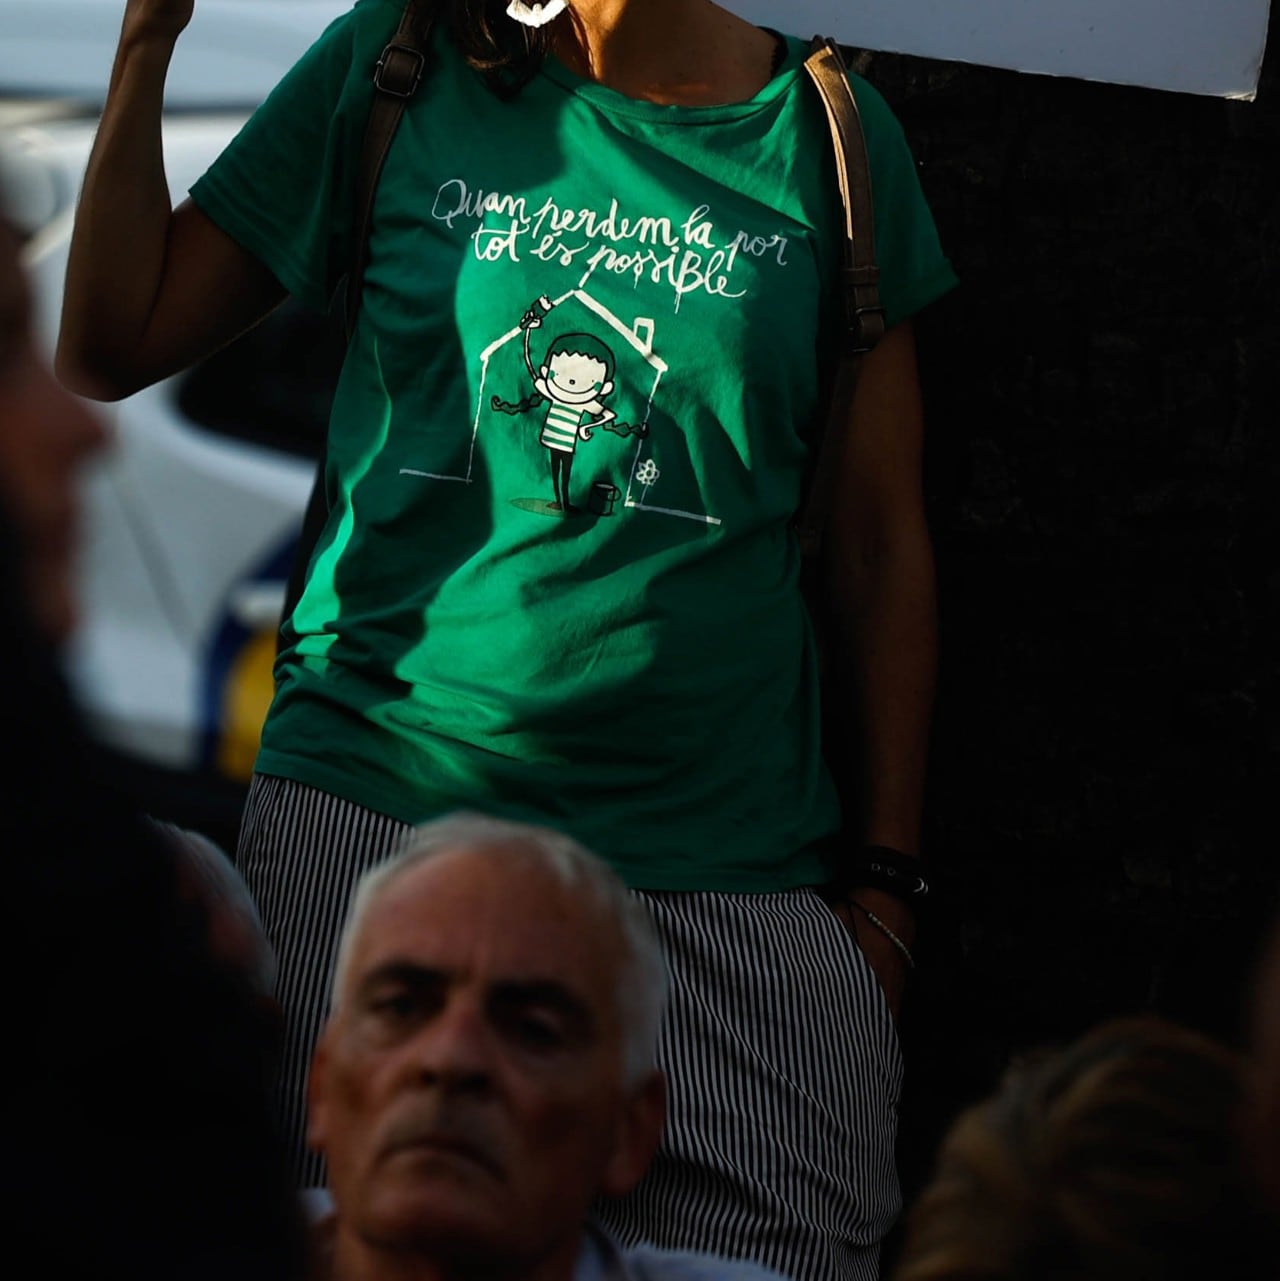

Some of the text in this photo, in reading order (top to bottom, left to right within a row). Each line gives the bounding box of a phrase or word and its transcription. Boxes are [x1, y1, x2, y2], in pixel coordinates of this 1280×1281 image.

[431, 178, 789, 272] Quan perdem la por
[471, 220, 529, 262] tot
